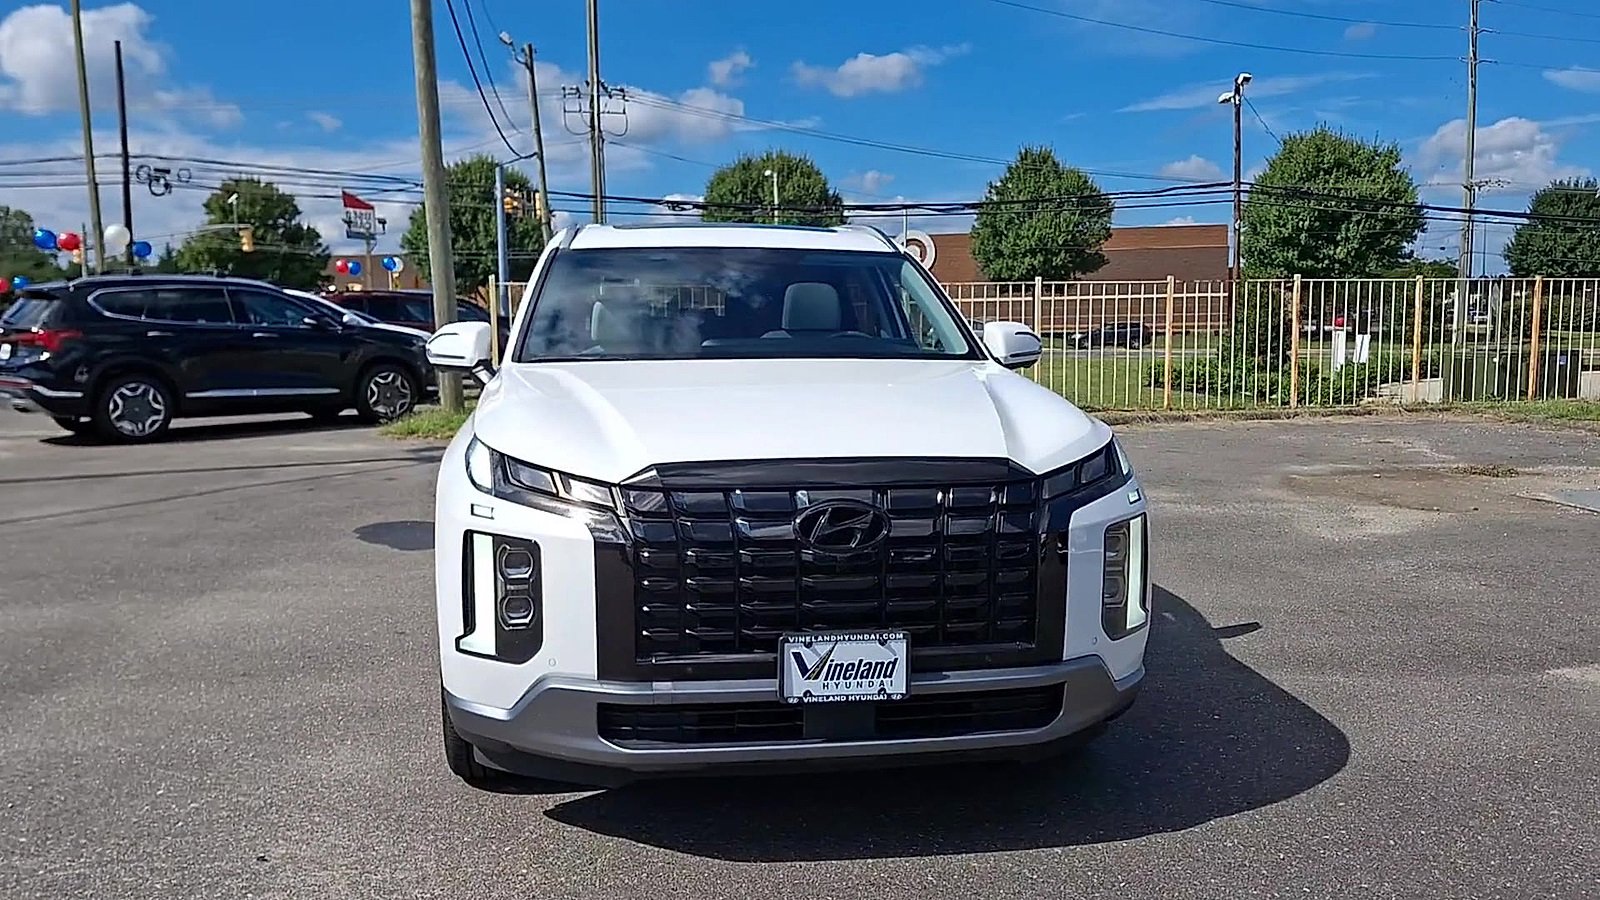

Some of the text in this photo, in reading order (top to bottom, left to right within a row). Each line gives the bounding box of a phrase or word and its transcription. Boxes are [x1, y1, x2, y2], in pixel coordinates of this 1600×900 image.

[788, 633, 903, 643] VINELANDHYUNDAI.COM
[791, 641, 899, 681] Vineland
[822, 679, 893, 690] HYUNDAI
[803, 694, 887, 703] VINELAND HYUNDAI
